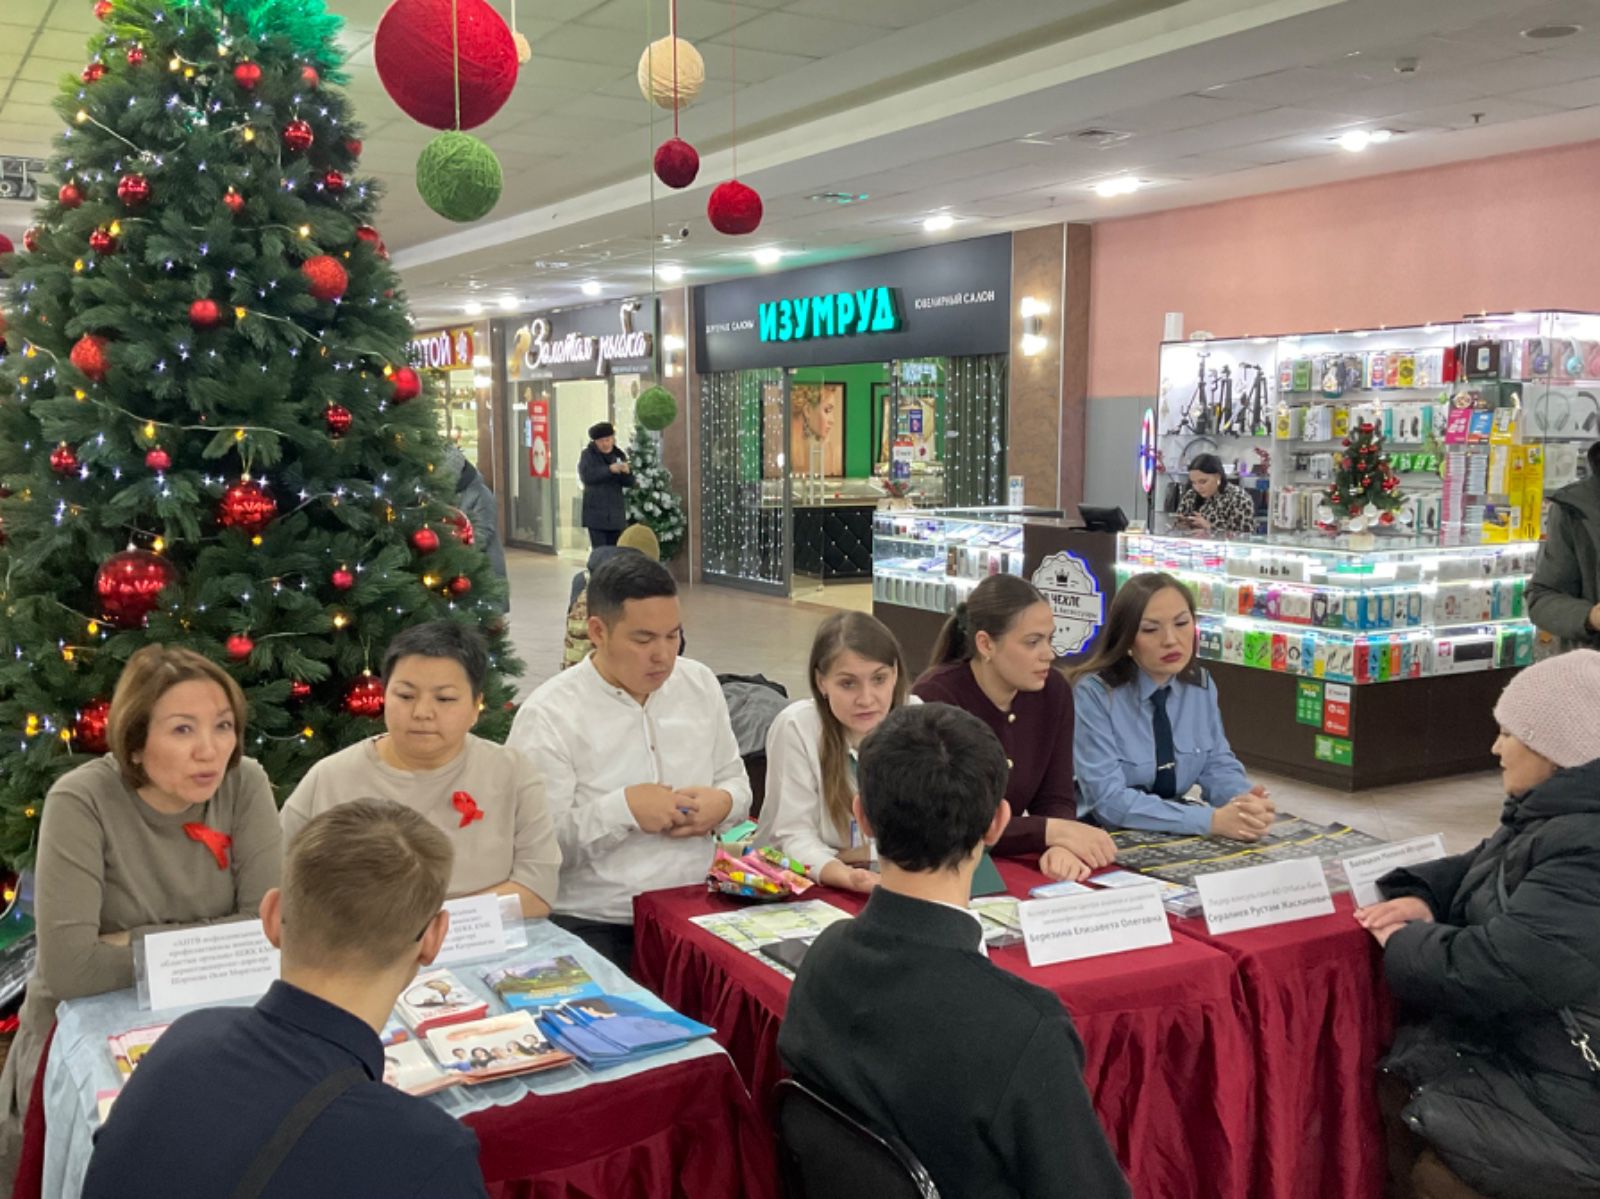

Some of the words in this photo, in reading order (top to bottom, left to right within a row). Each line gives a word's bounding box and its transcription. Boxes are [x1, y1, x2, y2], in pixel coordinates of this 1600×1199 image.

[963, 289, 995, 305] САЛОН
[758, 285, 896, 343] ИЗУМРУД
[1073, 922, 1120, 936] Елизавета
